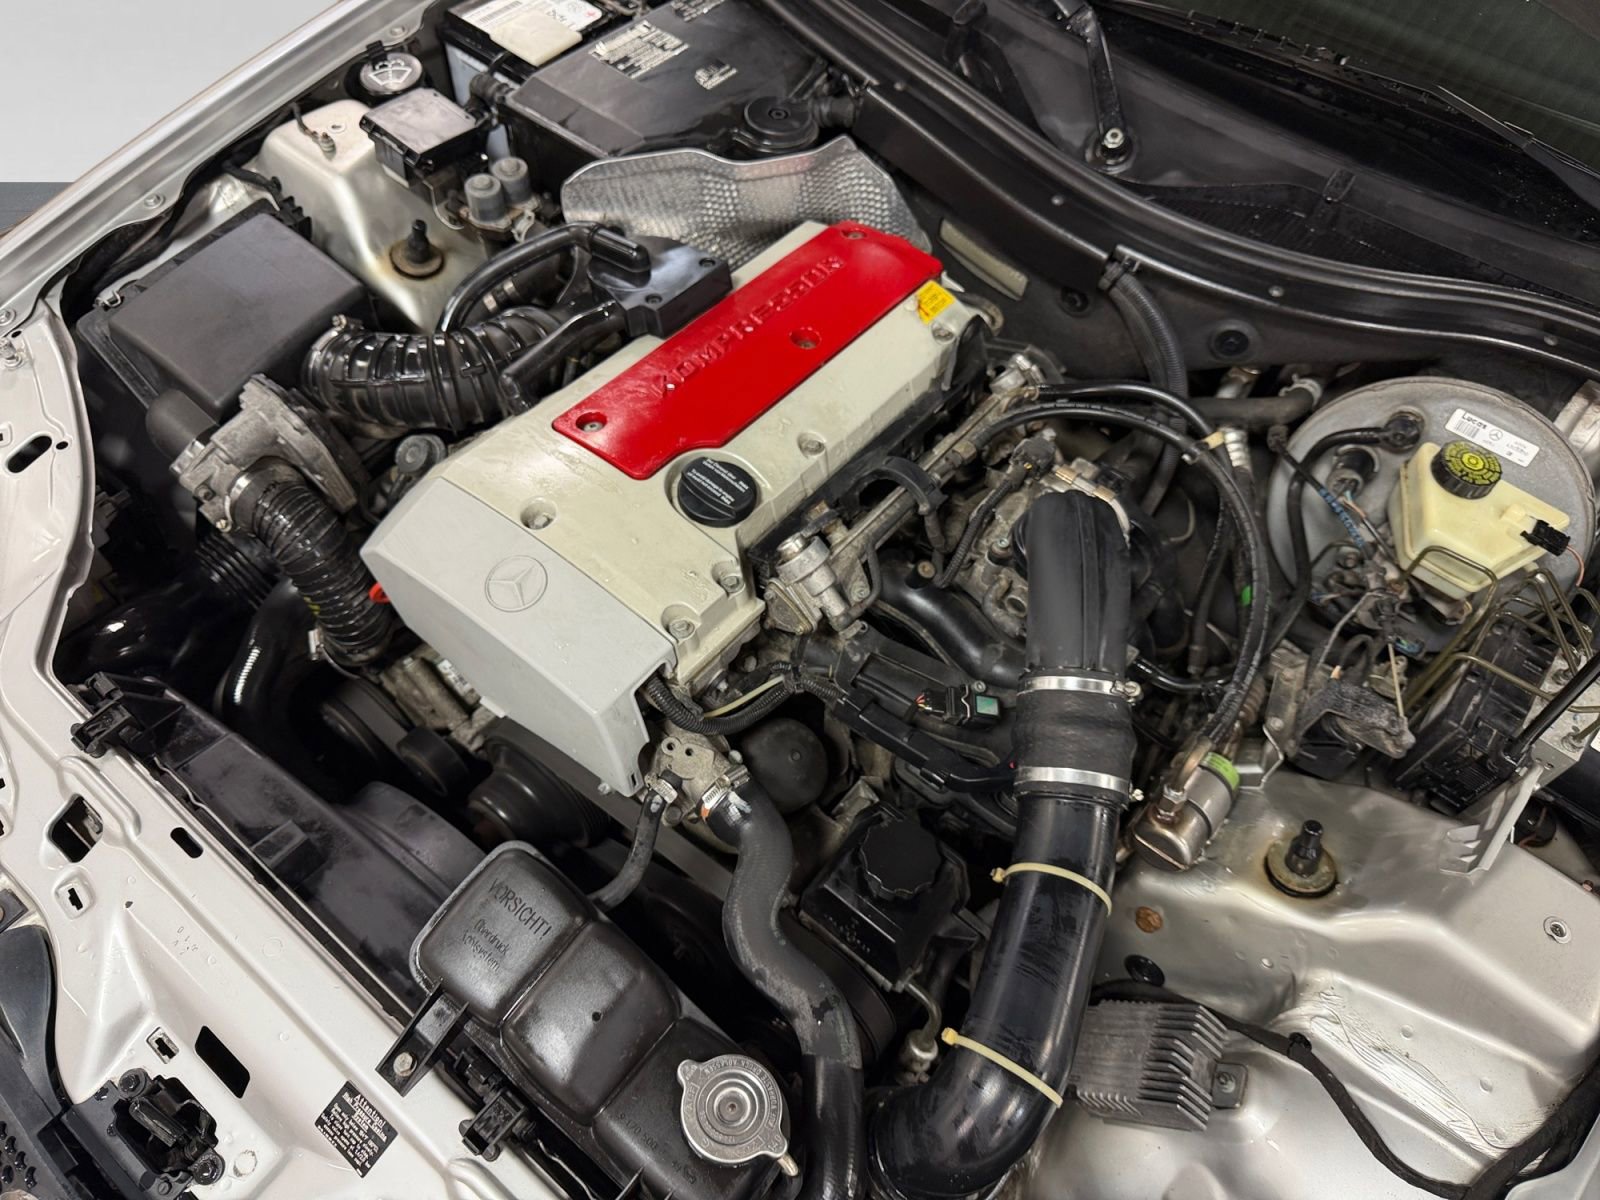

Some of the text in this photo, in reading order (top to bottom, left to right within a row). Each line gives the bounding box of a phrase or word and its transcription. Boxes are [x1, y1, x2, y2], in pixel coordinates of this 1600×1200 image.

[651, 255, 845, 399] KOMPRESSOR
[1462, 412, 1487, 429] Lucas
[488, 878, 552, 940] VORSICHT!
[354, 1094, 386, 1127] Attention!
